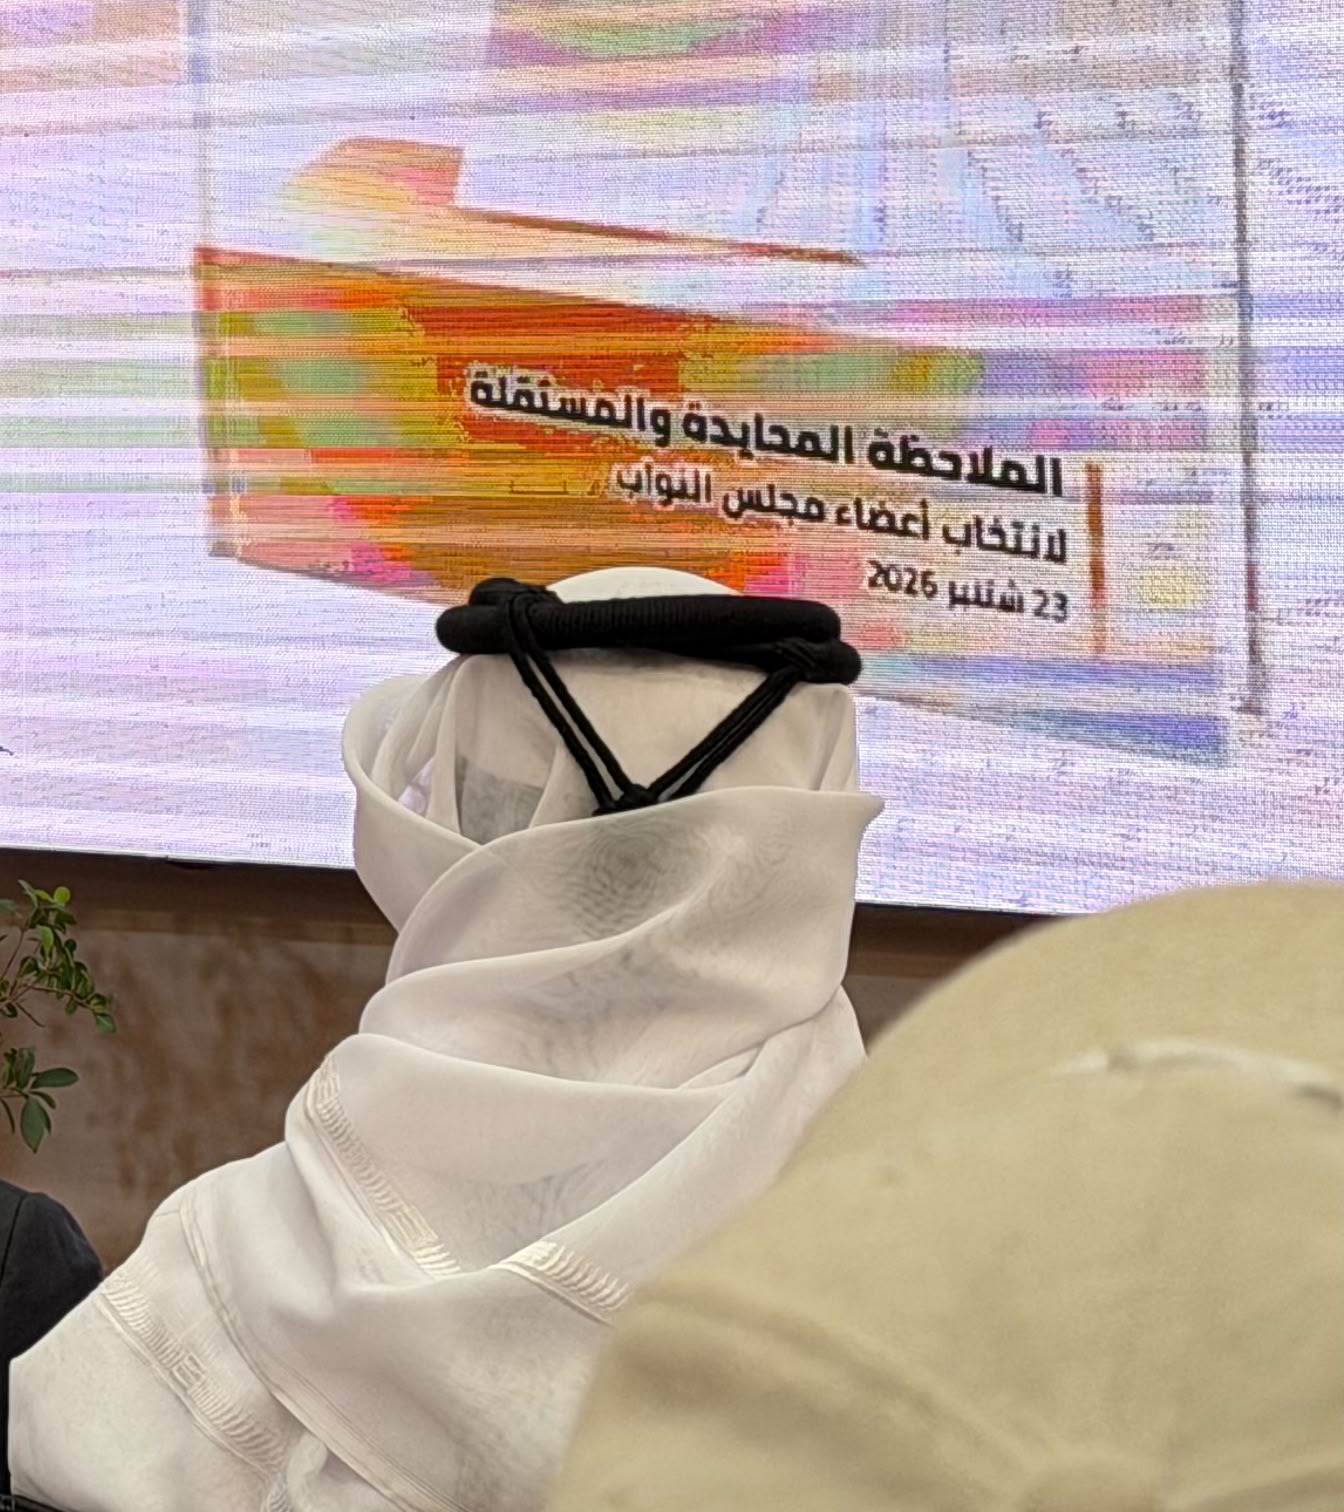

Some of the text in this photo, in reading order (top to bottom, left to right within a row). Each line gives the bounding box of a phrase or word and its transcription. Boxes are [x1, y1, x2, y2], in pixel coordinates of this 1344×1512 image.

[468, 366, 1064, 498] الملاحظة المحايدة والمستقلة
[615, 464, 1067, 563] لانتخاب أعضاء مجلس النواب
[868, 560, 1068, 622] 23 شتنبر 2026
